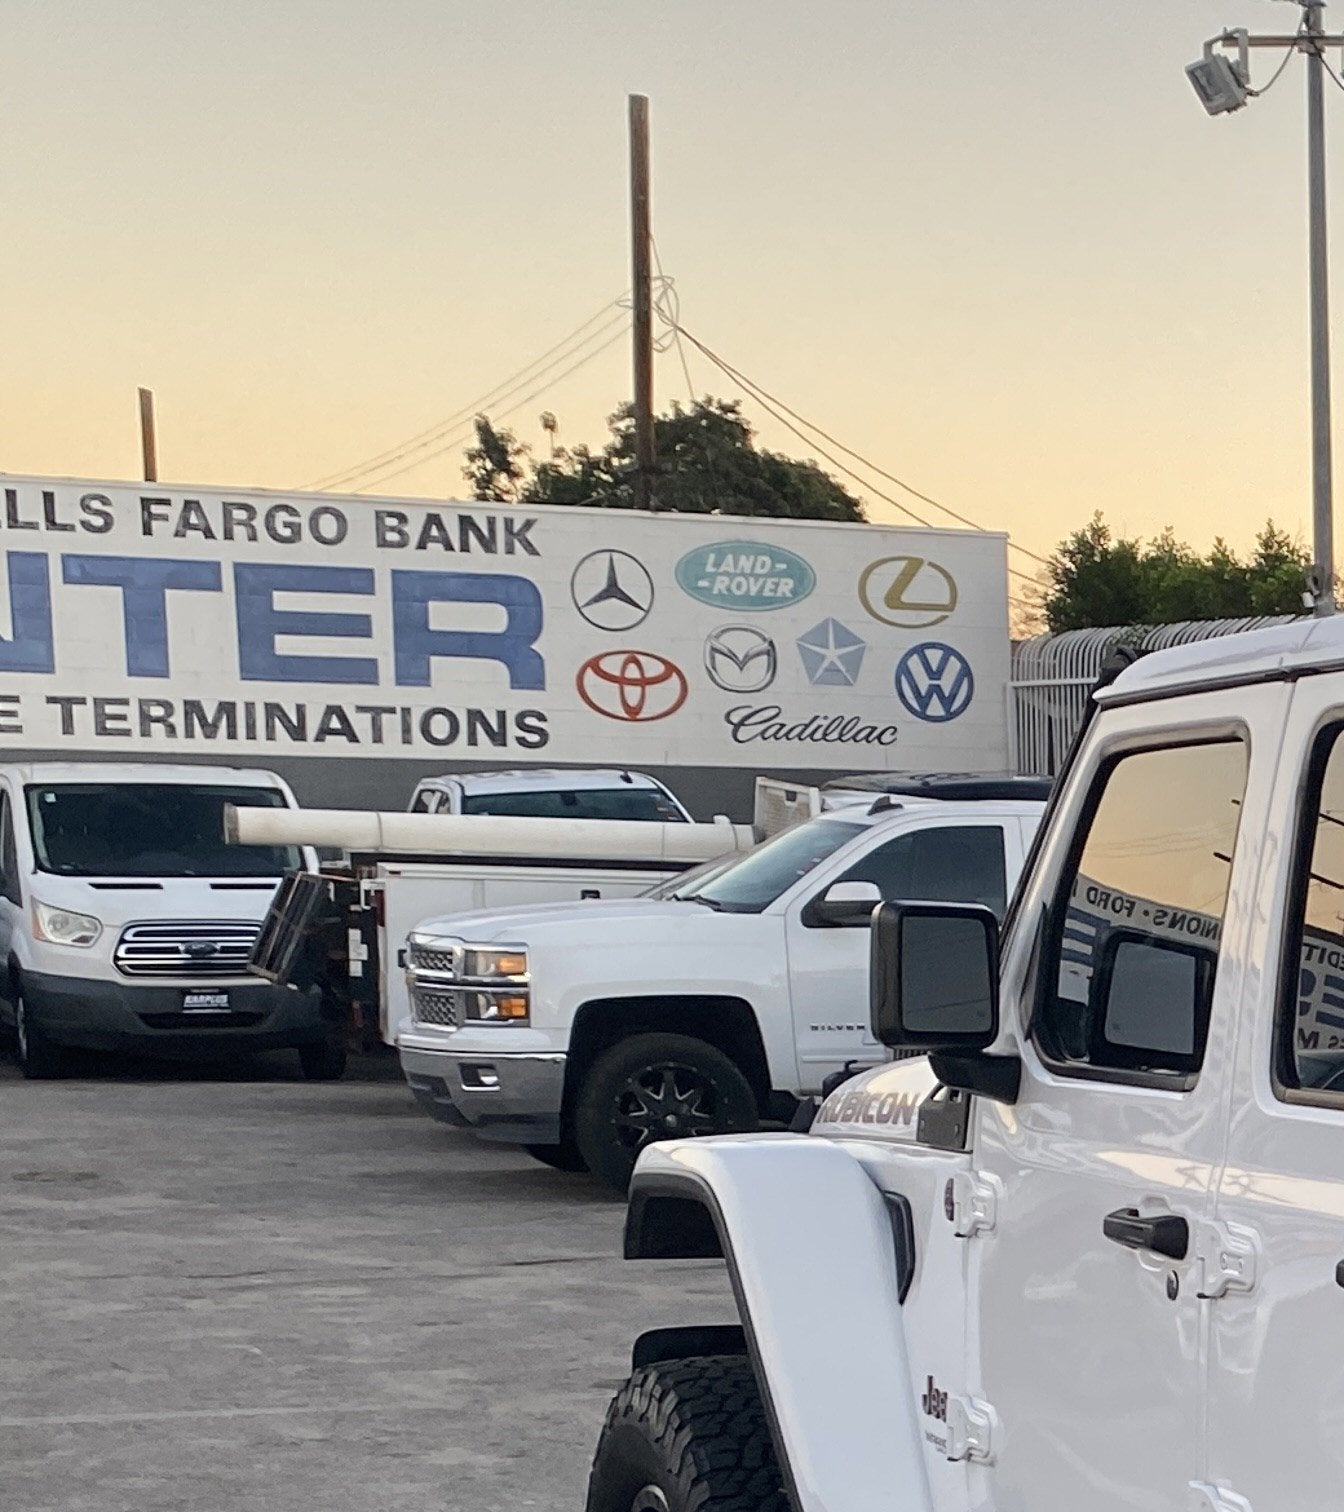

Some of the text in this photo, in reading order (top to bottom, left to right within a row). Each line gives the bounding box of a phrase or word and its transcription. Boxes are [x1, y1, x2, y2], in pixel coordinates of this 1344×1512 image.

[0, 489, 541, 556] LLS FARGO BANK
[45, 695, 549, 749] TERMINATIONS
[724, 705, 898, 746] Cadillac
[816, 1091, 921, 1125] RUBICON
